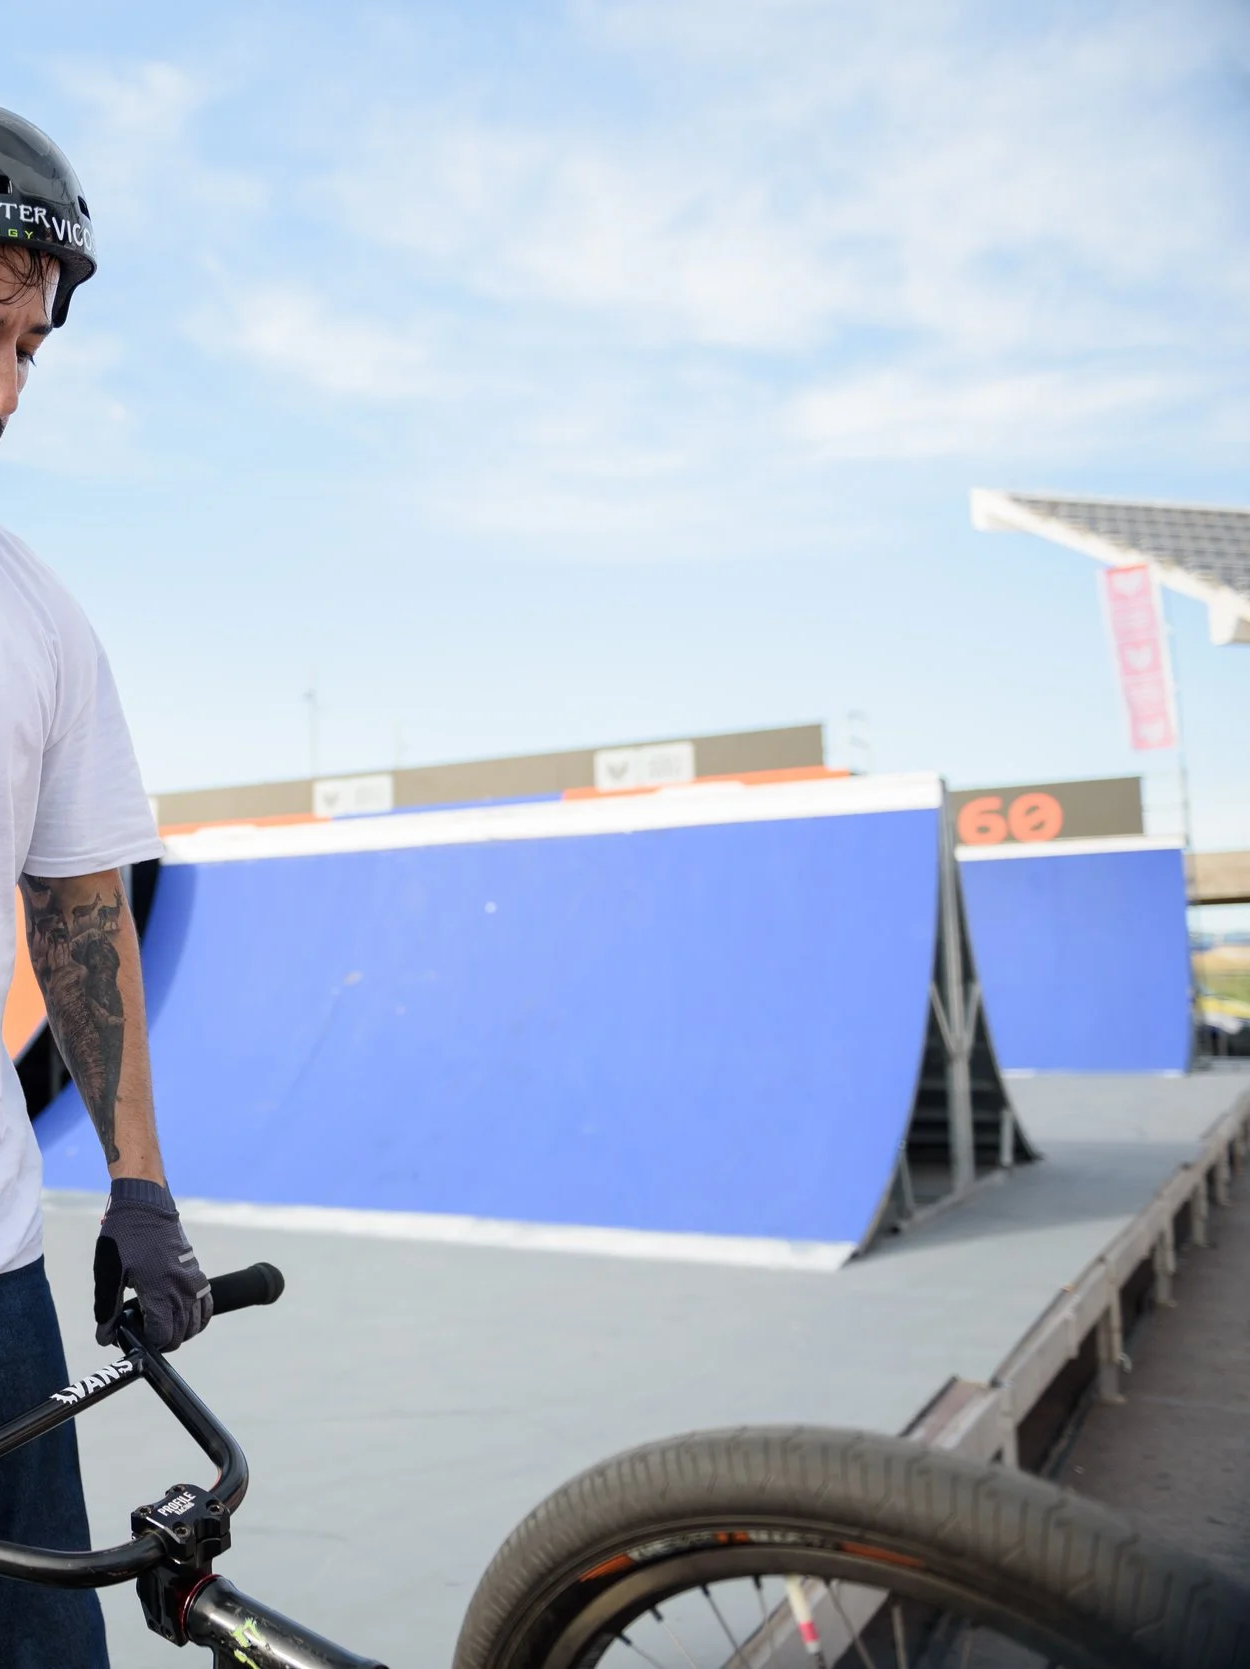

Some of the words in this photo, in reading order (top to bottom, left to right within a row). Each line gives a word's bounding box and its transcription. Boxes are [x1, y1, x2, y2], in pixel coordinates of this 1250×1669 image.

[52, 216, 94, 252] VICO
[957, 792, 1064, 845] 60
[61, 1357, 133, 1399] VANS
[157, 1491, 196, 1517] PROFILE
